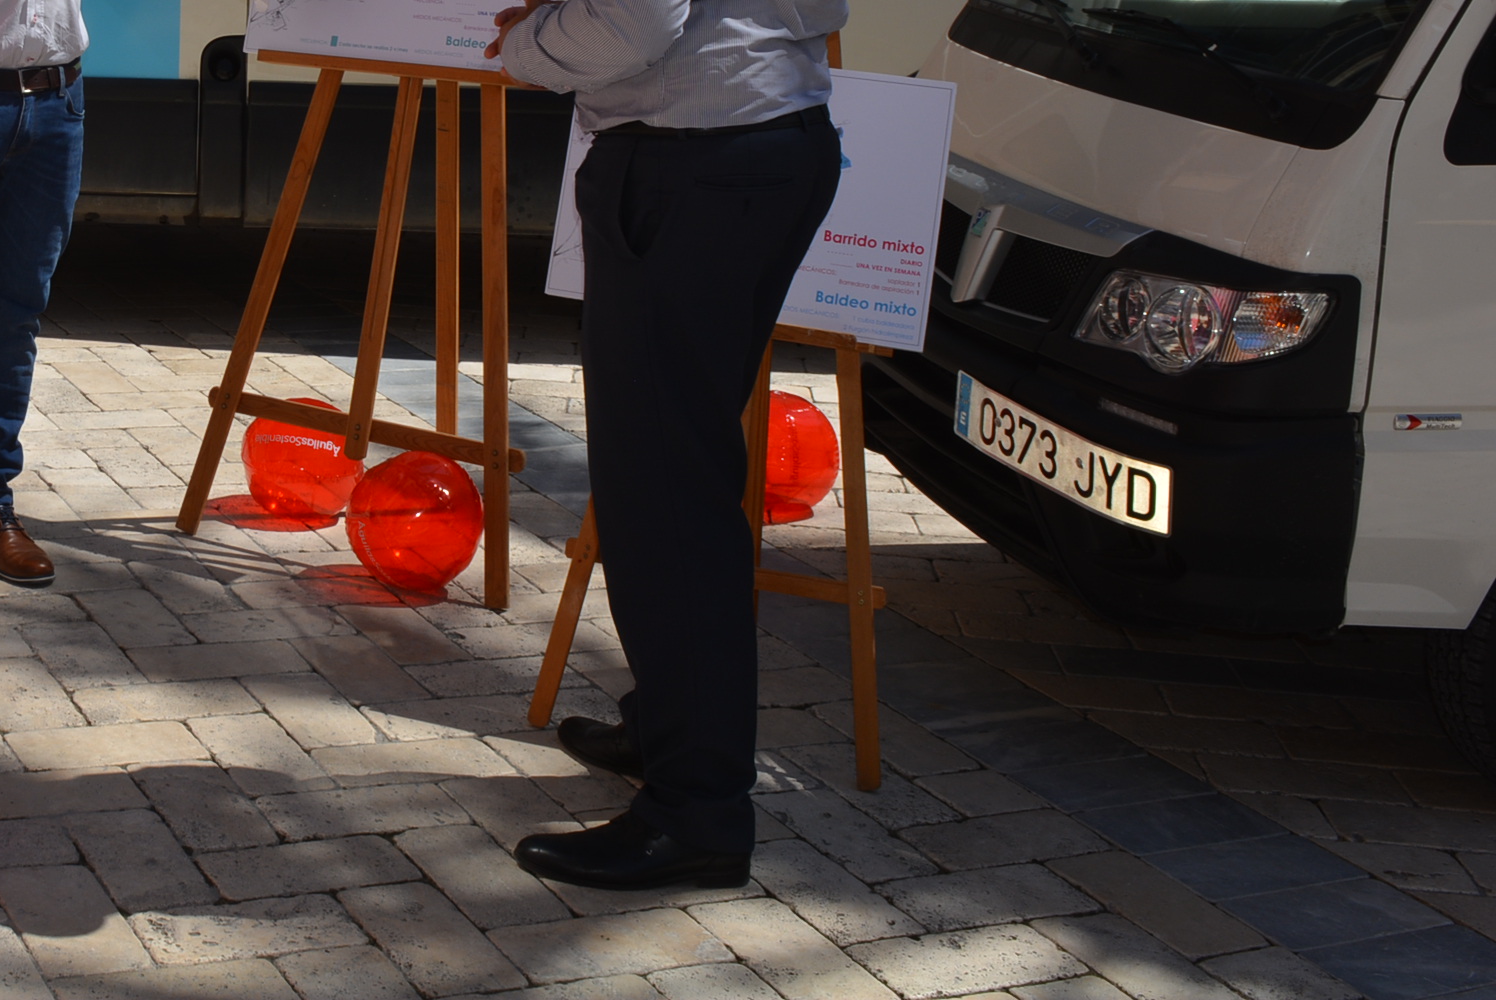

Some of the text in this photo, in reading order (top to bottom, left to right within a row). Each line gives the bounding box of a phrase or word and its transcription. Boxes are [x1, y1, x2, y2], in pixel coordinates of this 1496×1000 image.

[446, 35, 487, 49] Baldeo
[823, 229, 925, 255] Barrido mixto
[856, 262, 870, 270] UNA
[871, 264, 883, 272] VEZ
[894, 267, 921, 277] SEMANA
[900, 258, 923, 267] DIARIO
[838, 279, 870, 289] Barredora
[815, 290, 917, 317] Baldeo mixto
[959, 411, 967, 426] E
[979, 397, 1157, 522] 0373 JYD
